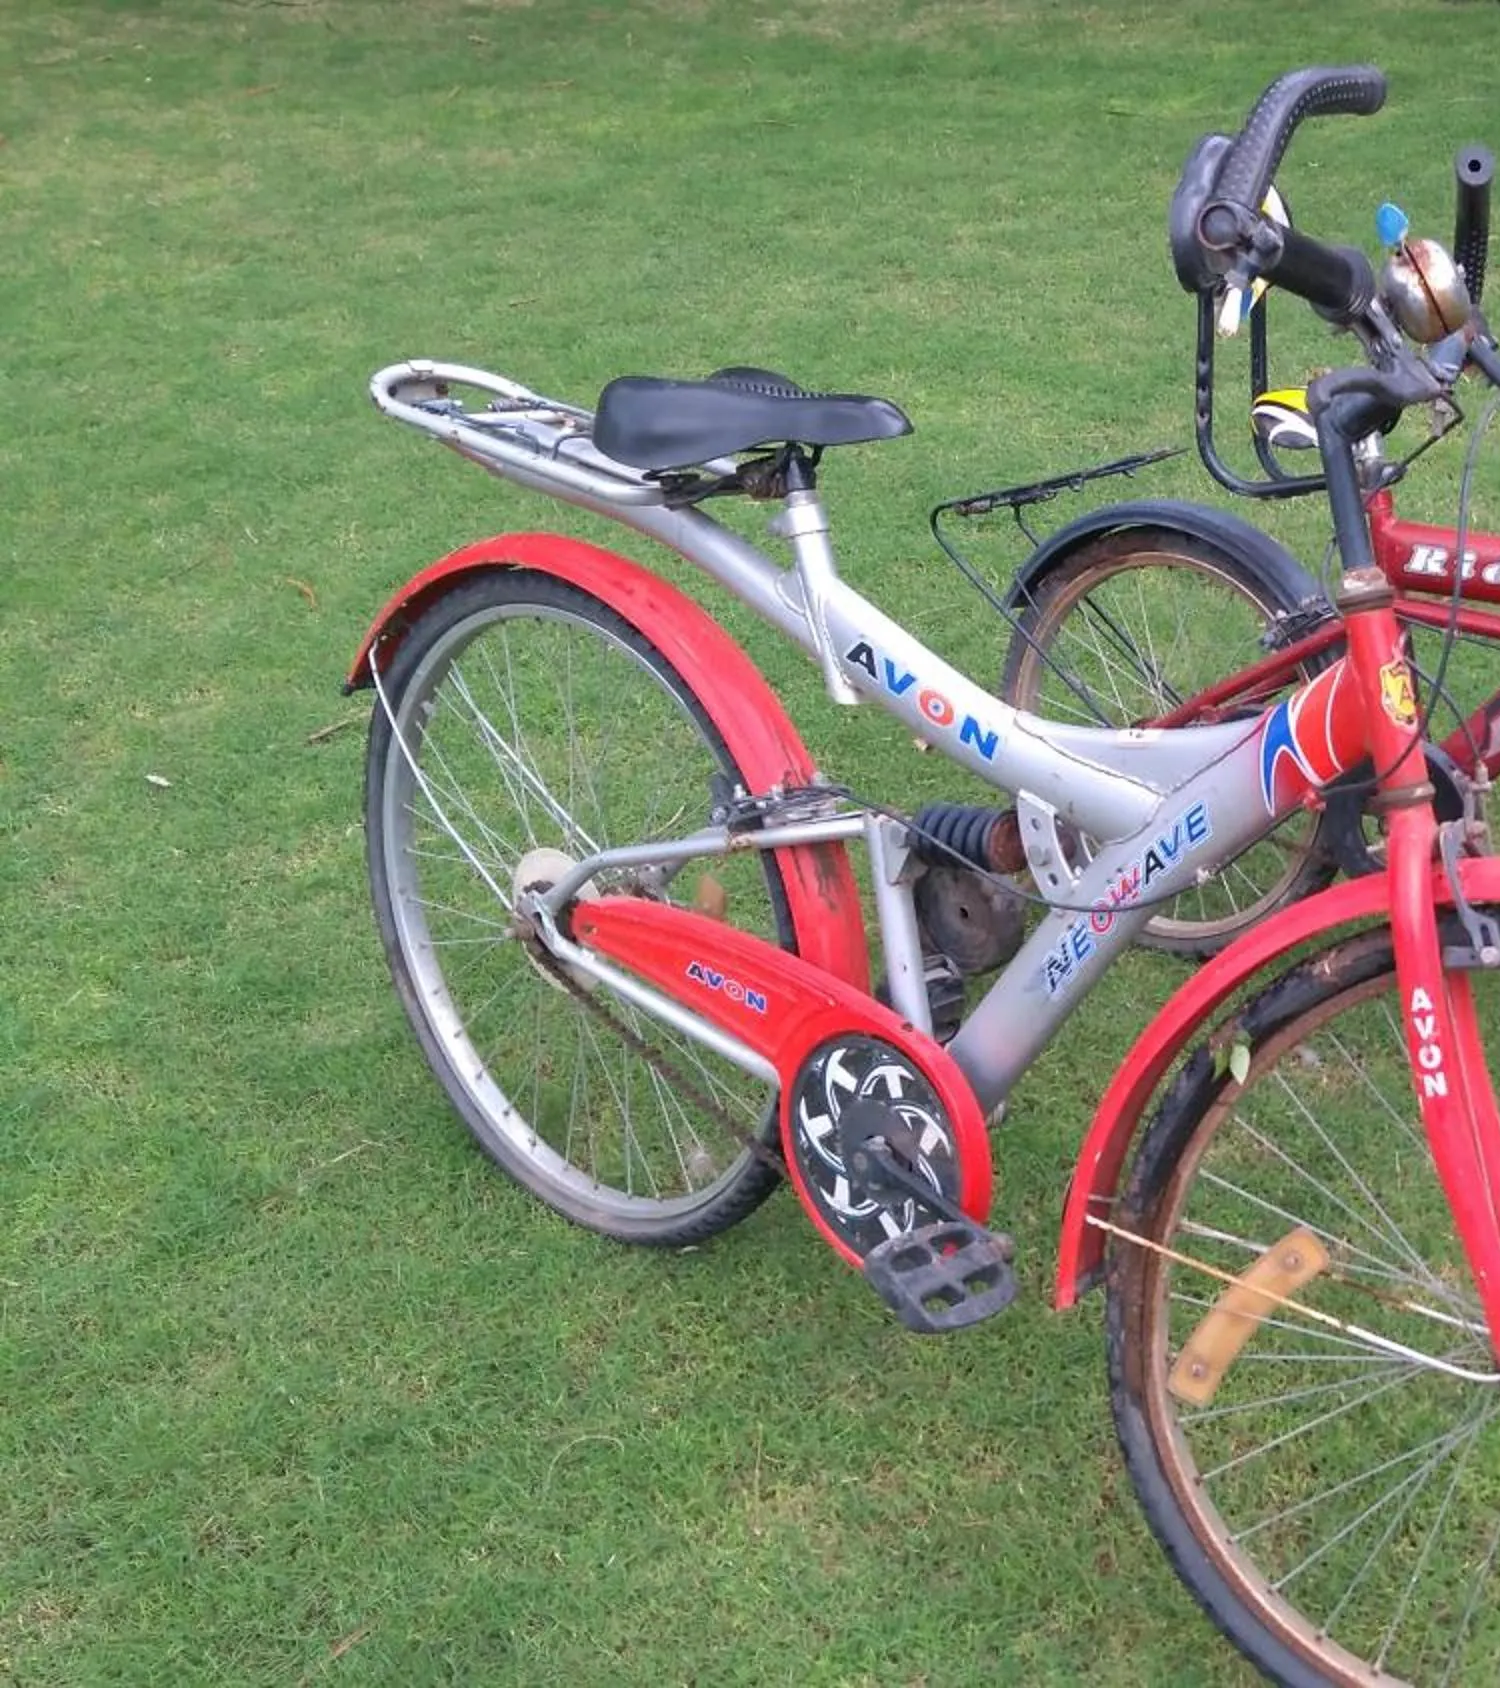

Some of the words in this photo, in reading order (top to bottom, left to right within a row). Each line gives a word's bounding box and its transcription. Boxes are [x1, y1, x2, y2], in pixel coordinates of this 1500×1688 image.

[846, 641, 998, 761] AVON
[1043, 802, 1211, 992] NEOWAVE
[685, 960, 766, 1013] AVON
[1411, 988, 1447, 1098] AVON
